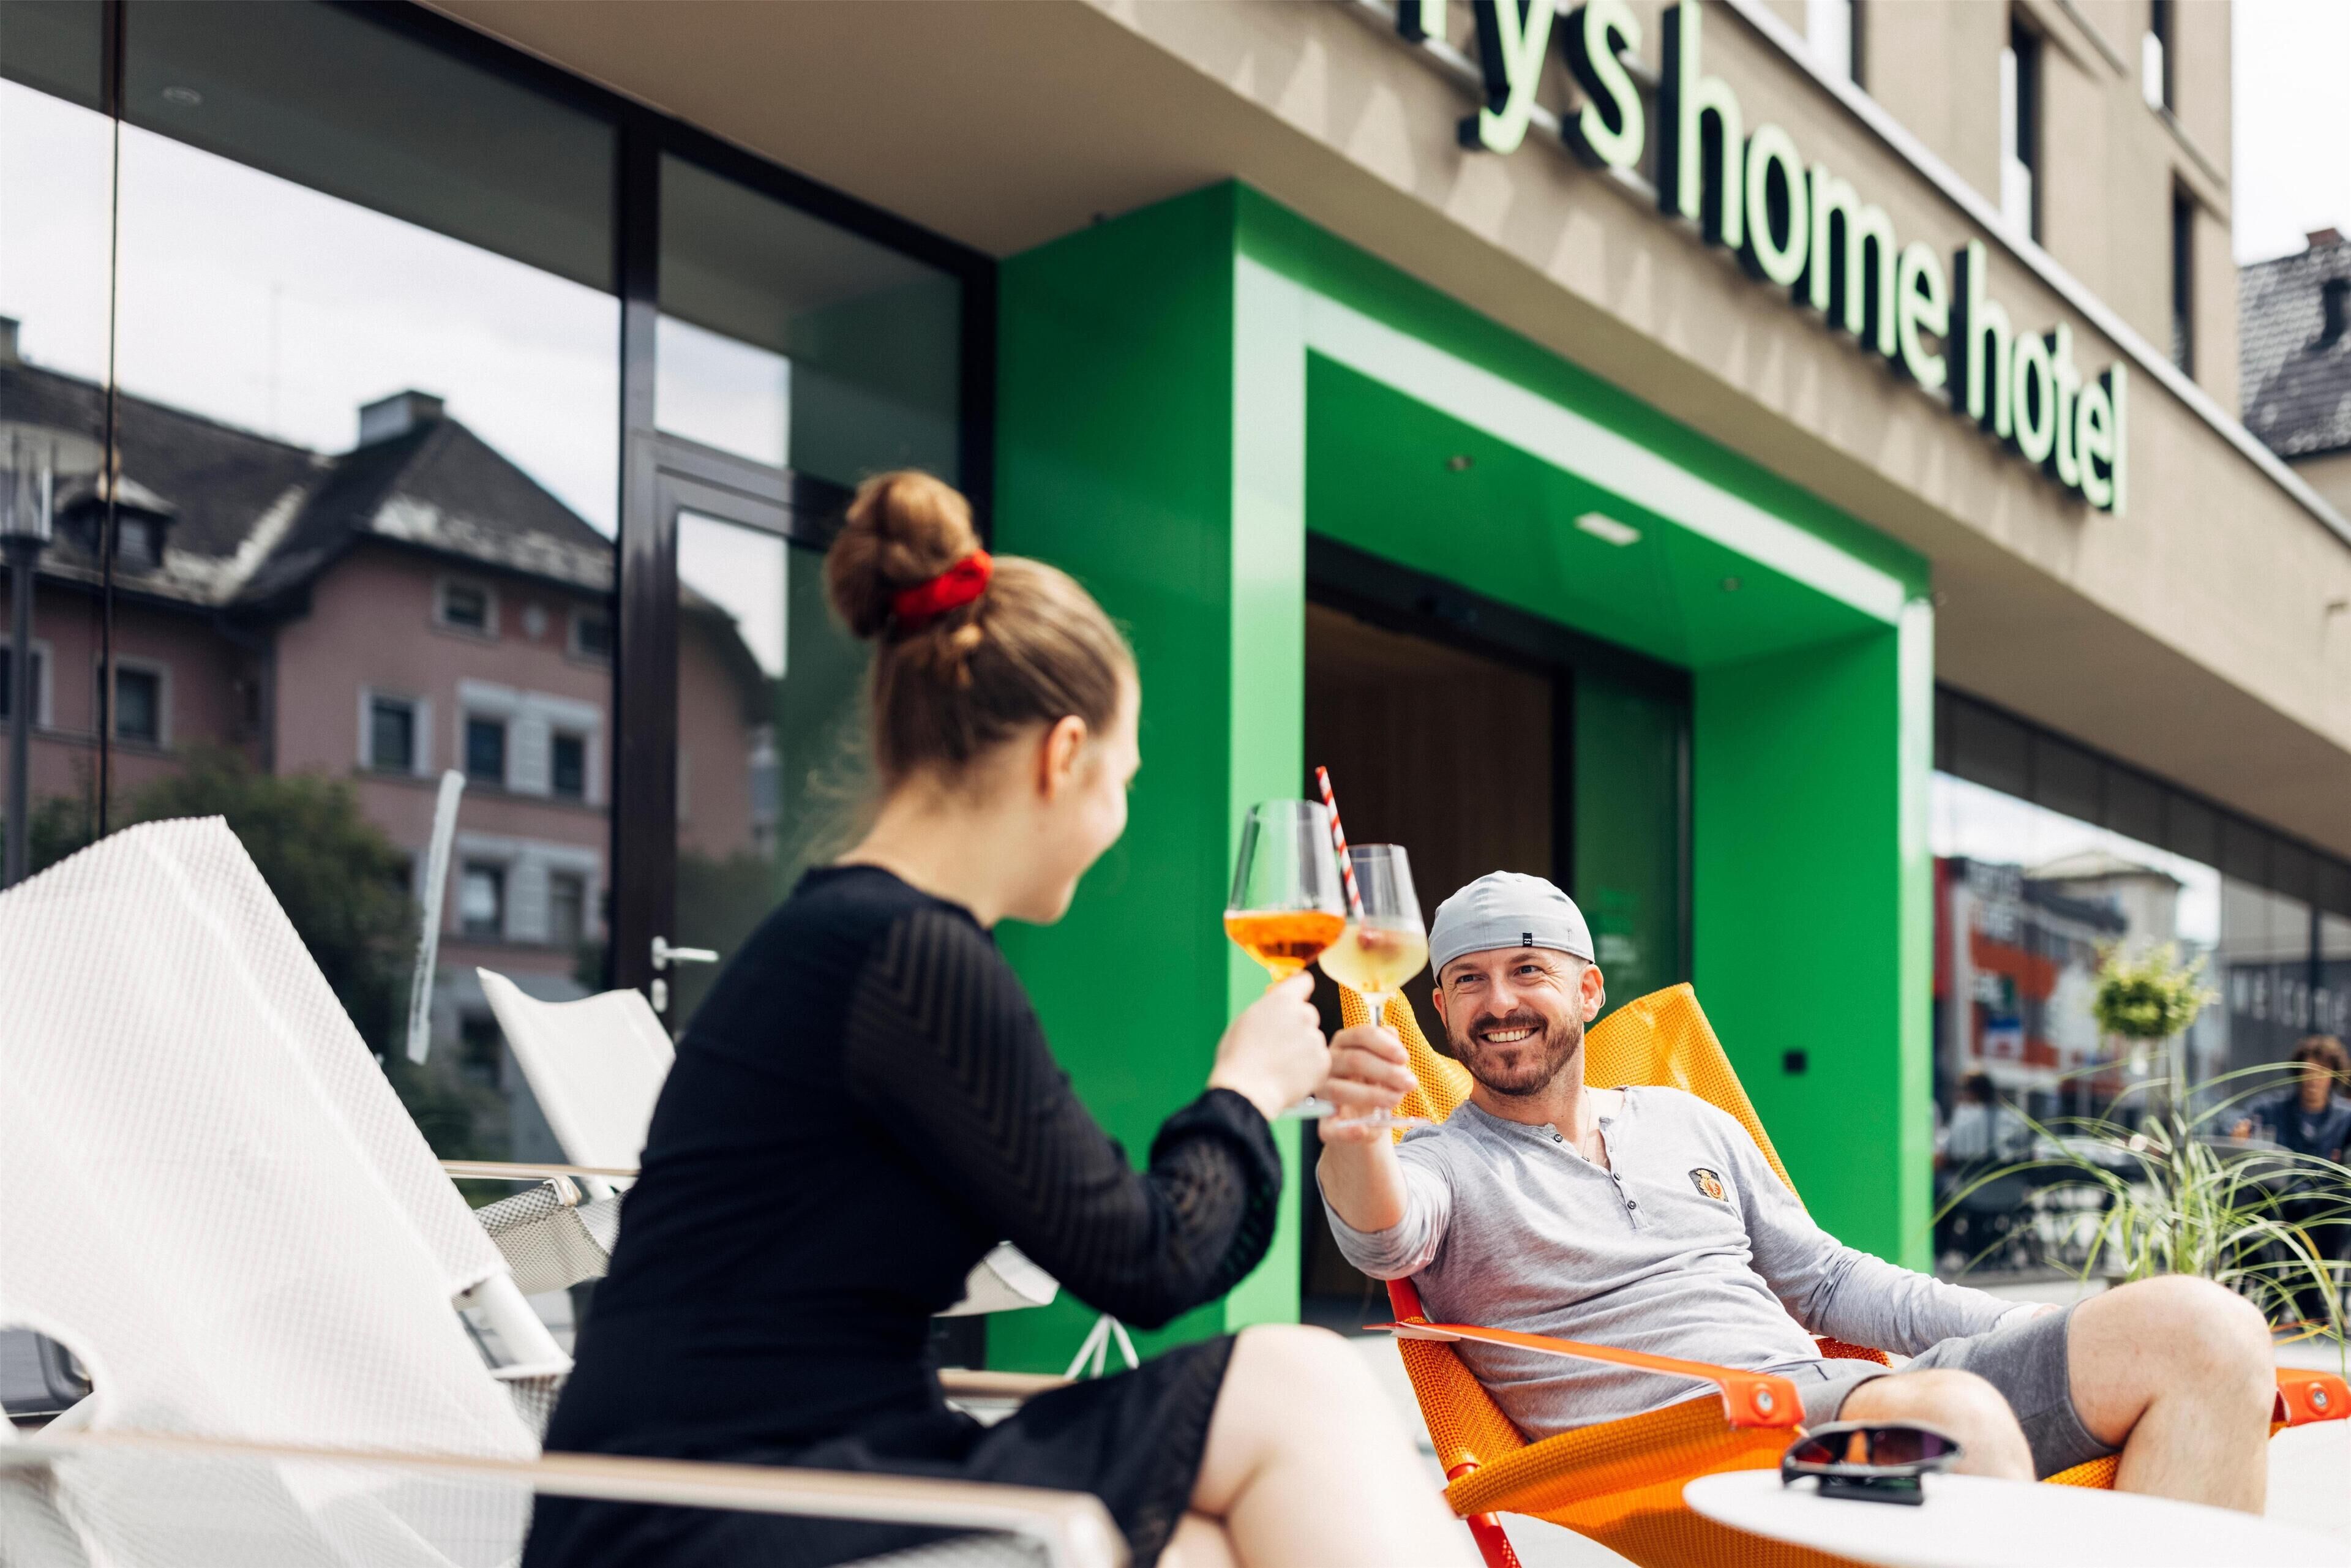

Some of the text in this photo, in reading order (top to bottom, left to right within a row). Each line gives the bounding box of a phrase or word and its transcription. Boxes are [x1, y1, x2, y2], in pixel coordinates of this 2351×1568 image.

[1418, 0, 2129, 518] ys home hotel
